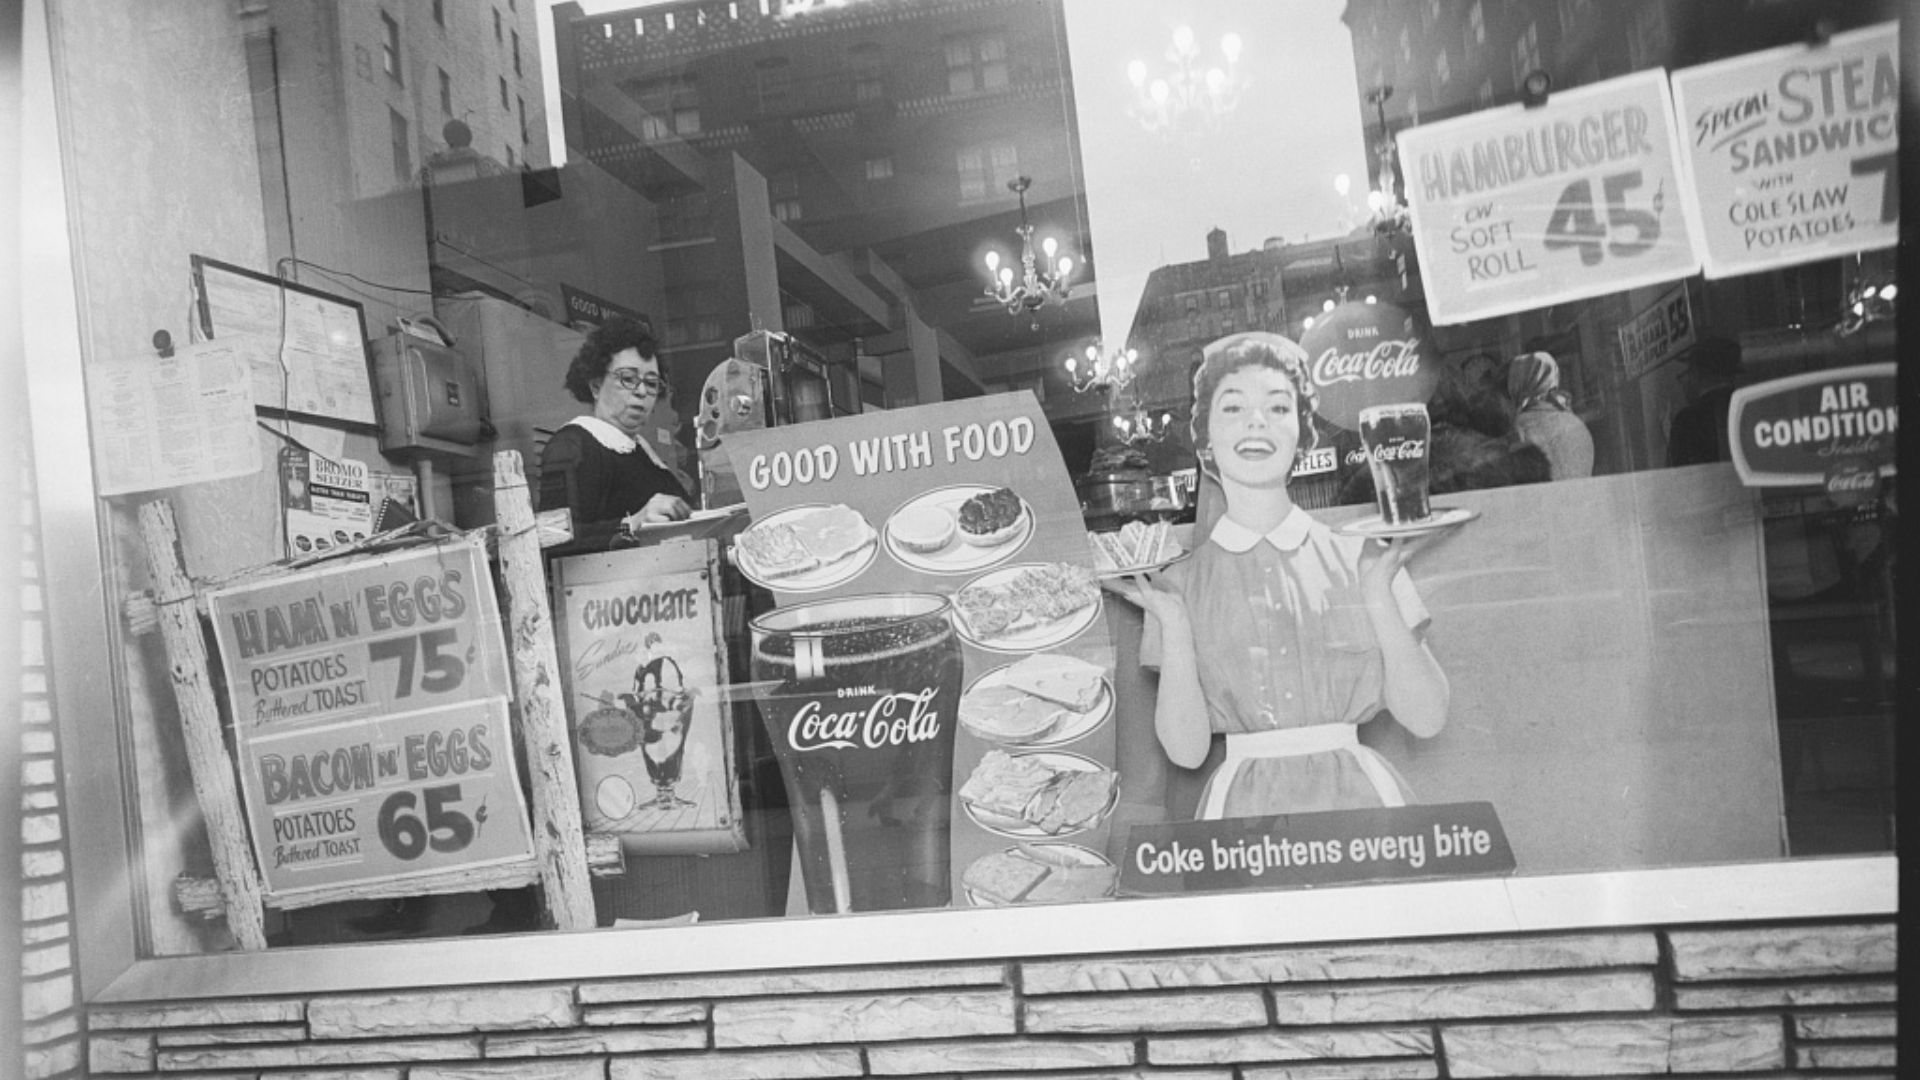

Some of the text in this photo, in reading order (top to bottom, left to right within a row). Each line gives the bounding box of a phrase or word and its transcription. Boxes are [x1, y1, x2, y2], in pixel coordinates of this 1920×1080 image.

[1419, 105, 1654, 200] HAMBURGER
[1729, 184, 1849, 226] COLE SLAW
[1450, 220, 1514, 253] SOFT
[1744, 212, 1856, 249] POTATOES
[1468, 249, 1537, 281] ROLL
[1347, 326, 1379, 340] DRINK
[1312, 337, 1420, 386] Coca-Cola
[1820, 382, 1870, 413] AIR
[315, 459, 363, 478] BROMO
[750, 416, 1035, 490] GOOD WITH FOOD
[1374, 440, 1424, 462] Coca-Cola
[251, 654, 348, 696] POTATOES
[837, 685, 877, 698] DRINK
[253, 680, 367, 726] Buttered TOAST
[788, 686, 940, 751] Coca-Cola
[260, 743, 375, 805] BACON
[404, 724, 492, 780] EGGS
[273, 808, 356, 843] POTATOES
[273, 838, 360, 868] Buttered TOAST
[1136, 824, 1491, 876] Coke brightens every bite
